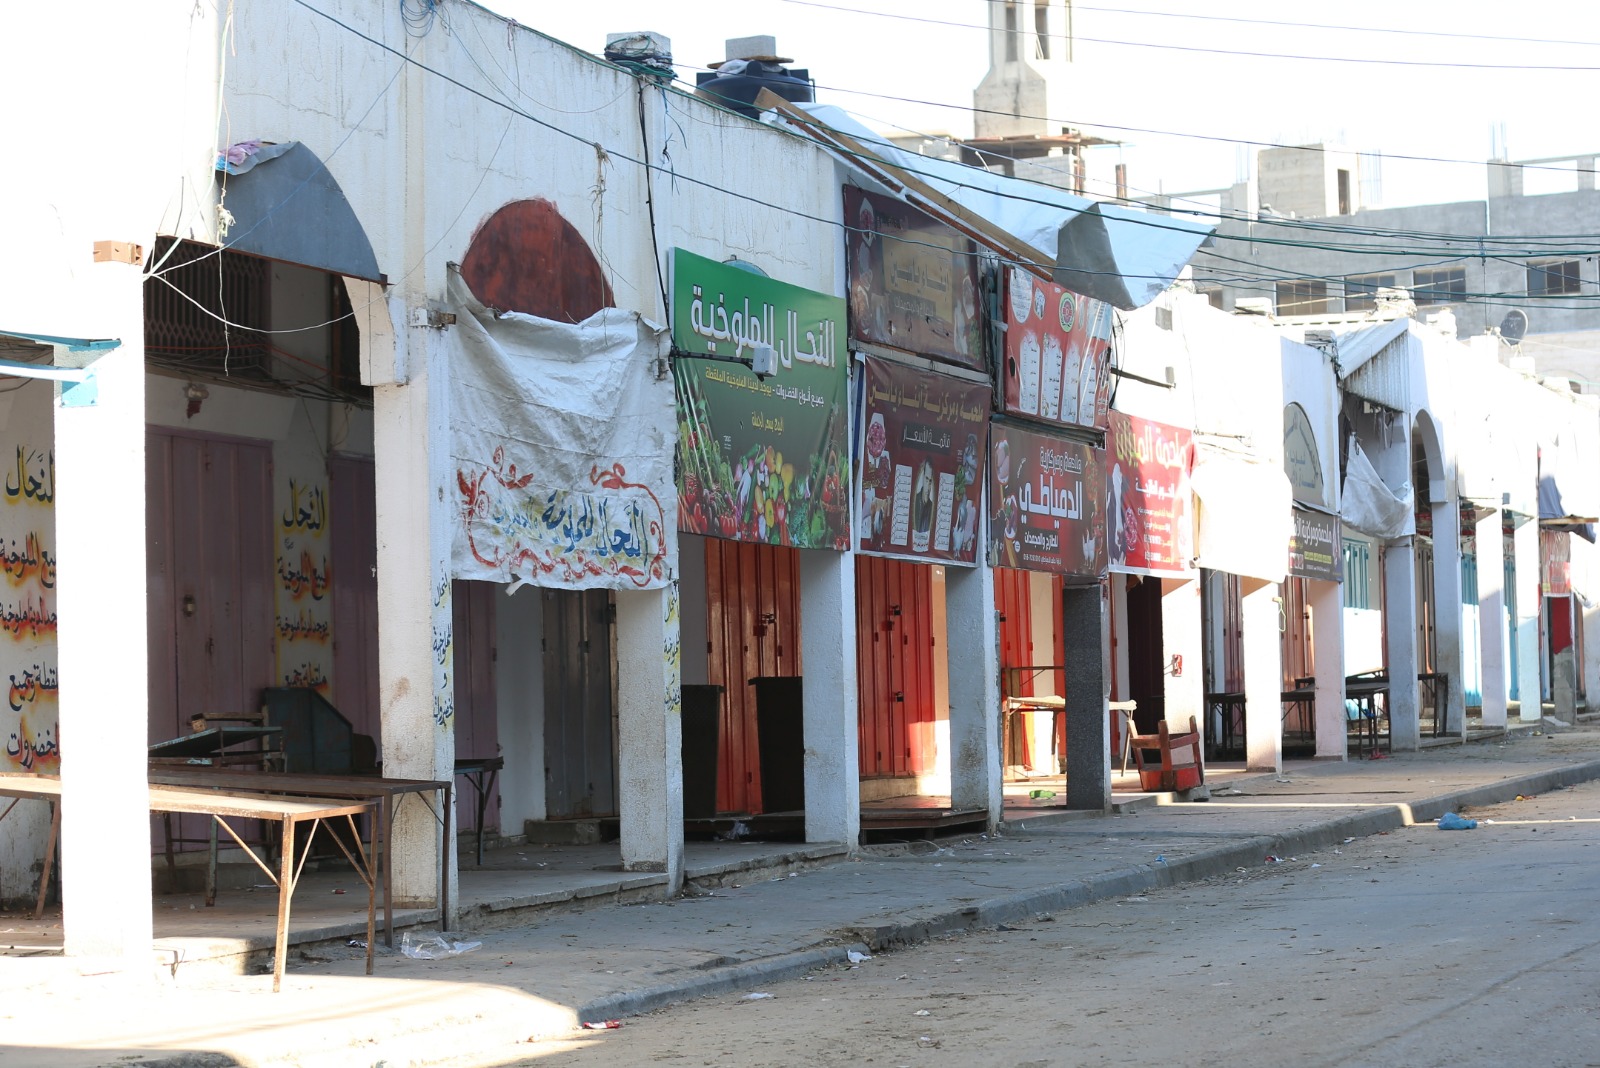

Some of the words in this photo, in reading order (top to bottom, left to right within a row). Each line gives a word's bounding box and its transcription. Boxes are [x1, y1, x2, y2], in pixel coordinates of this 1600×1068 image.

[780, 309, 835, 369] النحال
[760, 383, 772, 397] يوجد
[775, 384, 799, 400] الخضروات
[798, 385, 811, 405] أنواع
[811, 394, 825, 408] جميع
[868, 375, 898, 412] ياسين
[960, 393, 984, 423] ملحمة
[902, 425, 929, 444] الأسعار
[930, 429, 951, 449] قائمة
[1040, 446, 1064, 477] ومركزية
[1064, 451, 1082, 475] ملحمة
[1156, 426, 1187, 474] ملحمة
[1018, 473, 1083, 529] الدمياطي
[9, 667, 36, 712] وجميع
[34, 661, 60, 691] لقطة
[441, 672, 448, 689] و
[7, 722, 60, 770] لخضروات
